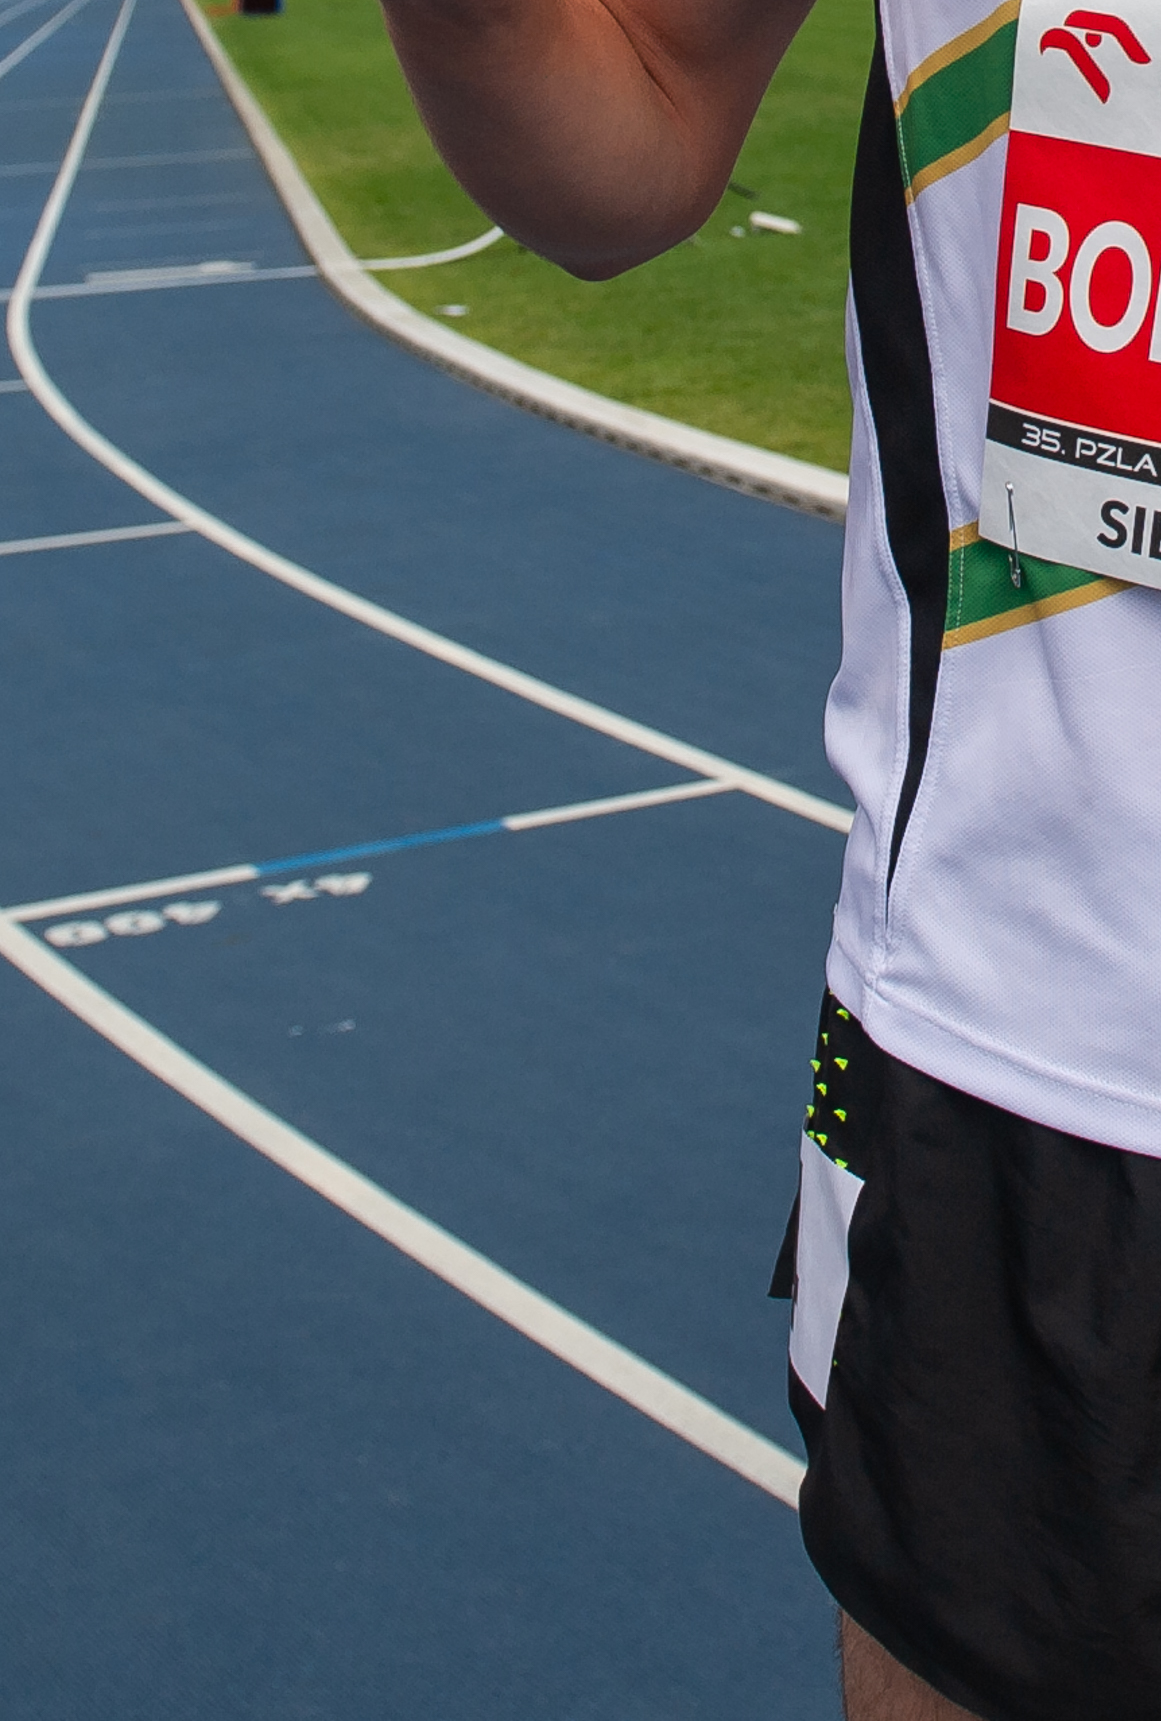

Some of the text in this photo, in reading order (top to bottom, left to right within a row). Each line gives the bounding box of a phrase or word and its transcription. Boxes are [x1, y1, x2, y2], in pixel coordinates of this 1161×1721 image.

[1021, 422, 1066, 456] 35.
[1075, 437, 1159, 478] PZLA
[43, 899, 222, 949] 400
